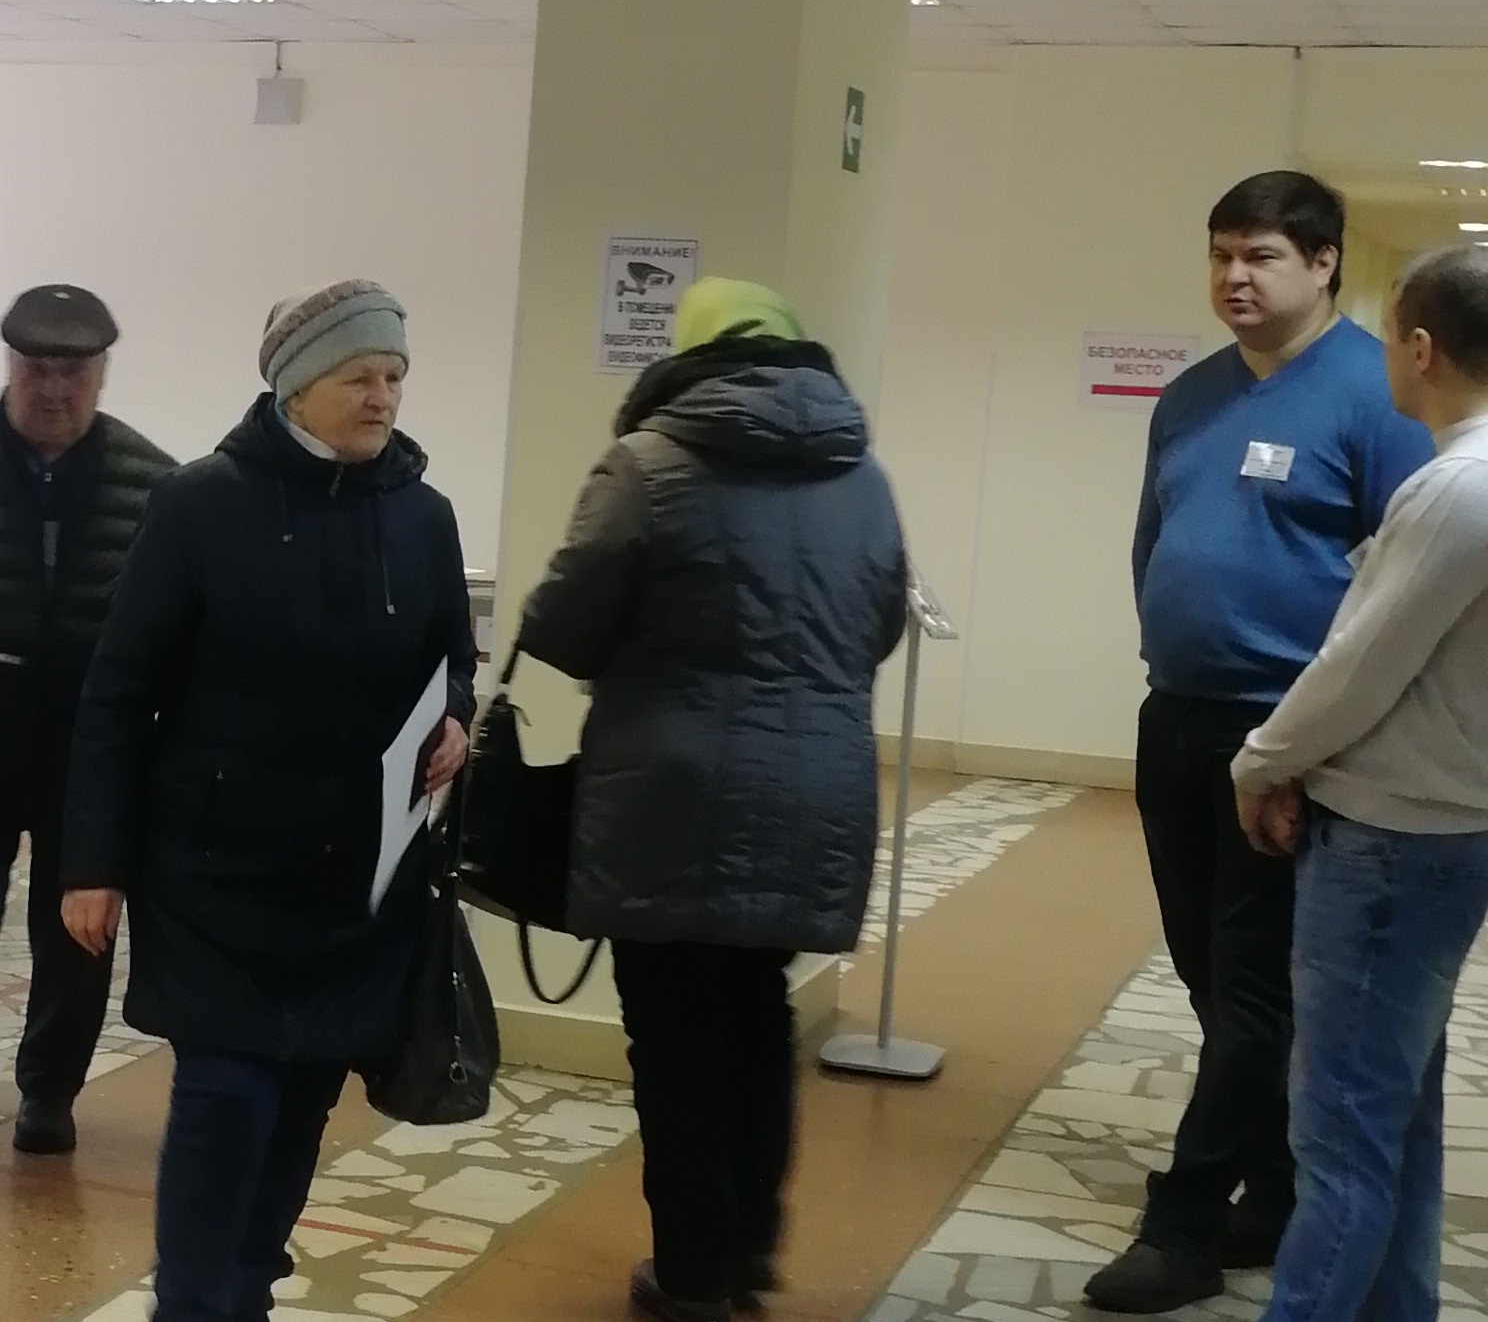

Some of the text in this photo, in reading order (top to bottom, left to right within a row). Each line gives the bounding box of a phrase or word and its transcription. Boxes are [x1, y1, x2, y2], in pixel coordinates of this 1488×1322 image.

[612, 245, 691, 258] ВНИМАНИЕ
[1087, 346, 1187, 362] БЕЗОПАСНОЕ
[1114, 363, 1164, 375] МЕСТО
